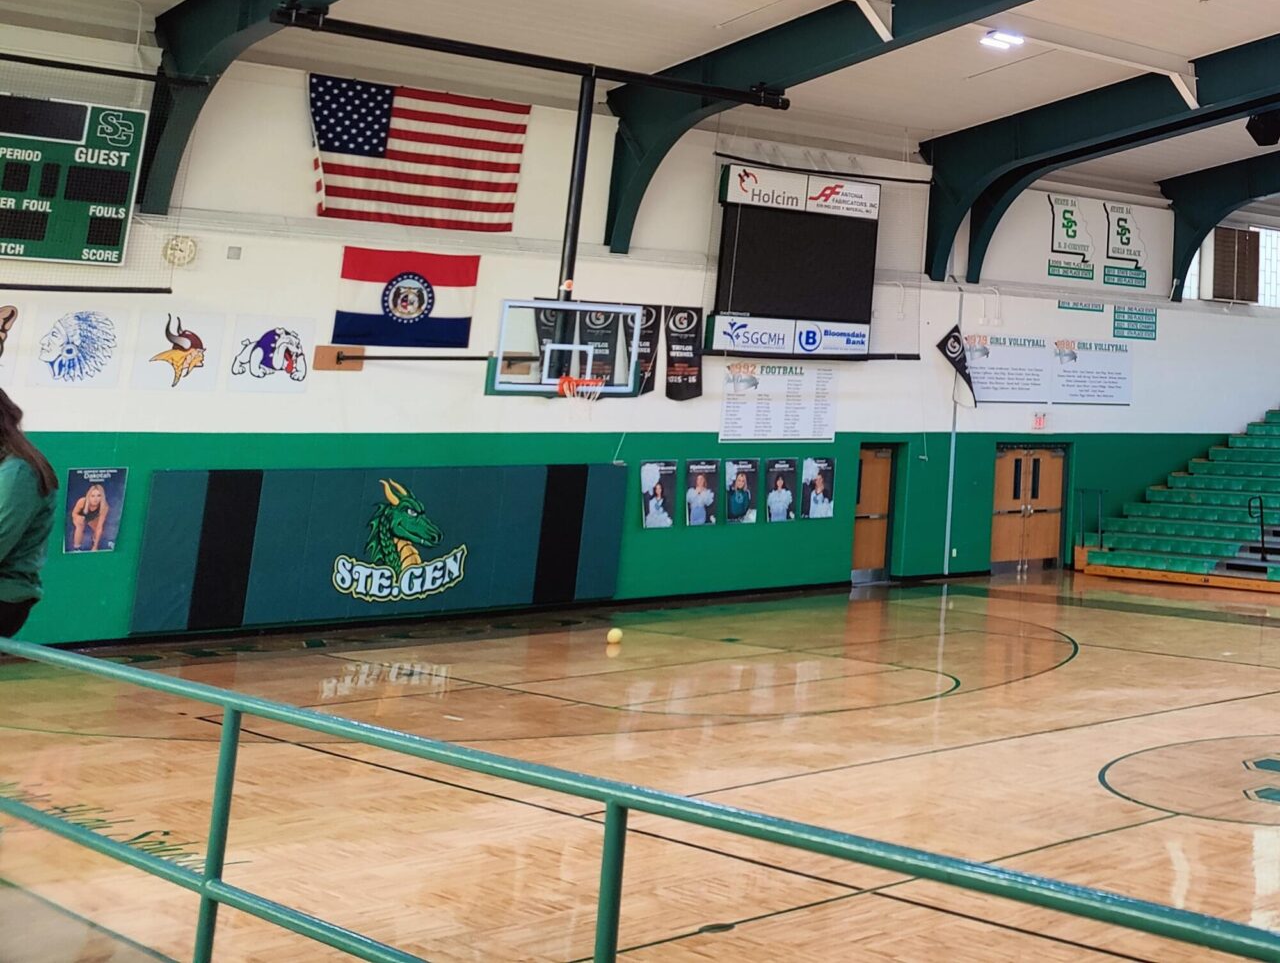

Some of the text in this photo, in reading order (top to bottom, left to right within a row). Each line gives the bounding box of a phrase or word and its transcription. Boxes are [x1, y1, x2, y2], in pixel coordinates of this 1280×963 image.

[0, 148, 42, 162] PERIOD
[74, 147, 131, 167] GUEST
[751, 189, 799, 207] Holcim
[0, 198, 53, 213] ER FOUL
[88, 205, 126, 219] FOULS
[0, 242, 25, 255] TCH
[81, 249, 120, 262] SCORE
[742, 331, 785, 346] SGCMH
[805, 330, 817, 346] B
[824, 329, 866, 339] Bloomsdale
[846, 338, 865, 346] Bank
[1008, 338, 1046, 347] VOLLEYBALL
[1094, 343, 1128, 352] VOLLEYBALL
[760, 365, 805, 376] FOOTBALL
